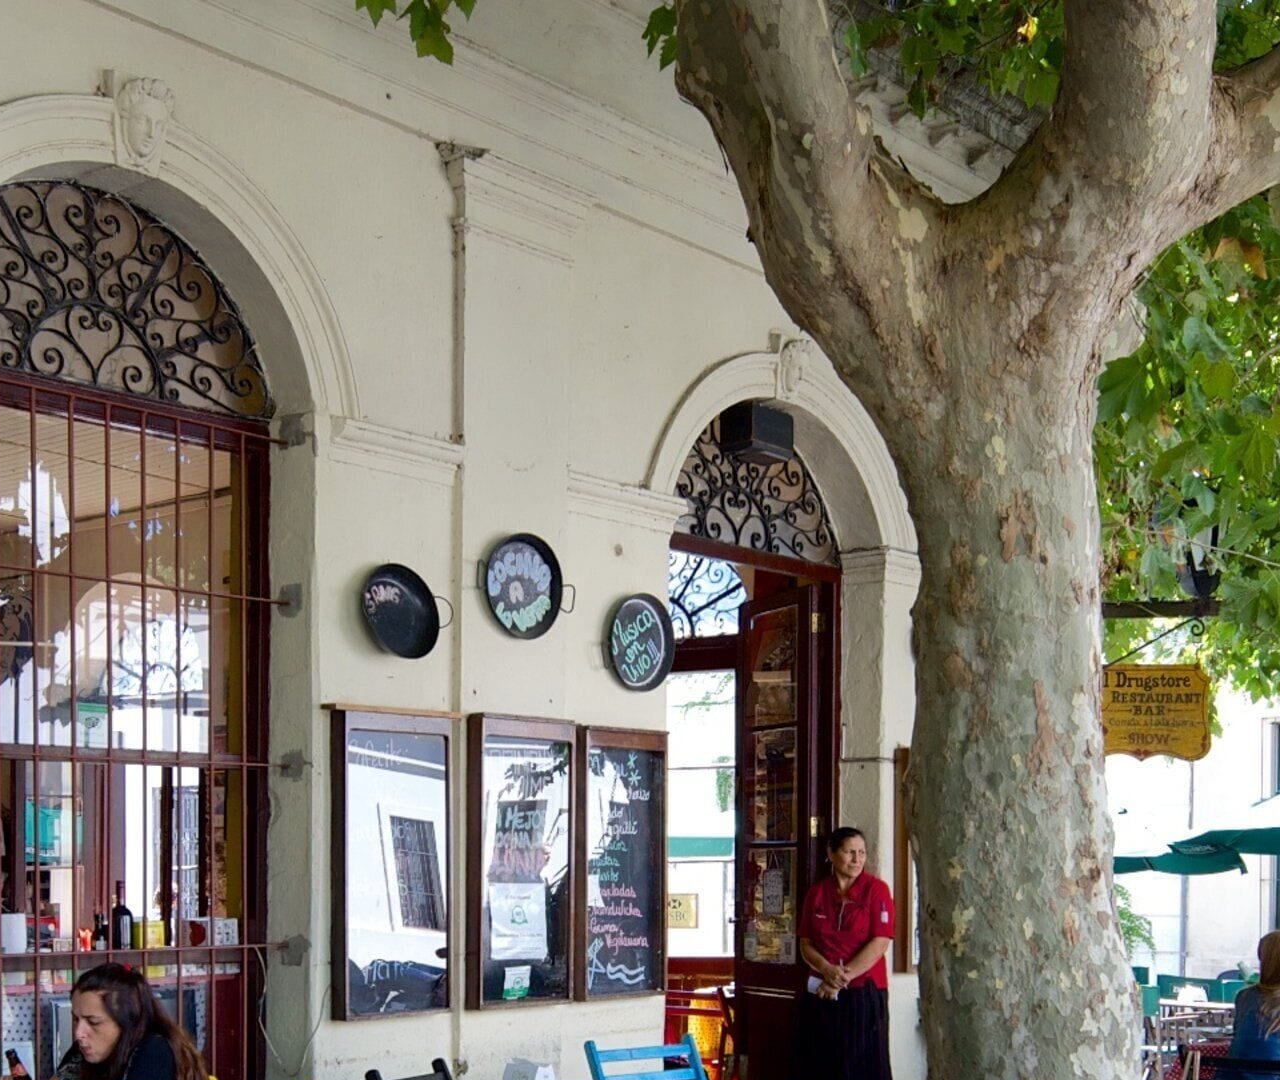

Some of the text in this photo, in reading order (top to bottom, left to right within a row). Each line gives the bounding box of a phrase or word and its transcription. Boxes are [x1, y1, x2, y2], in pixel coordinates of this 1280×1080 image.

[625, 641, 645, 663] en
[1115, 671, 1192, 691] Drugstore
[1111, 690, 1203, 705] RESTAURANT
[1132, 705, 1166, 716] BAR
[1128, 732, 1171, 744] SHOW
